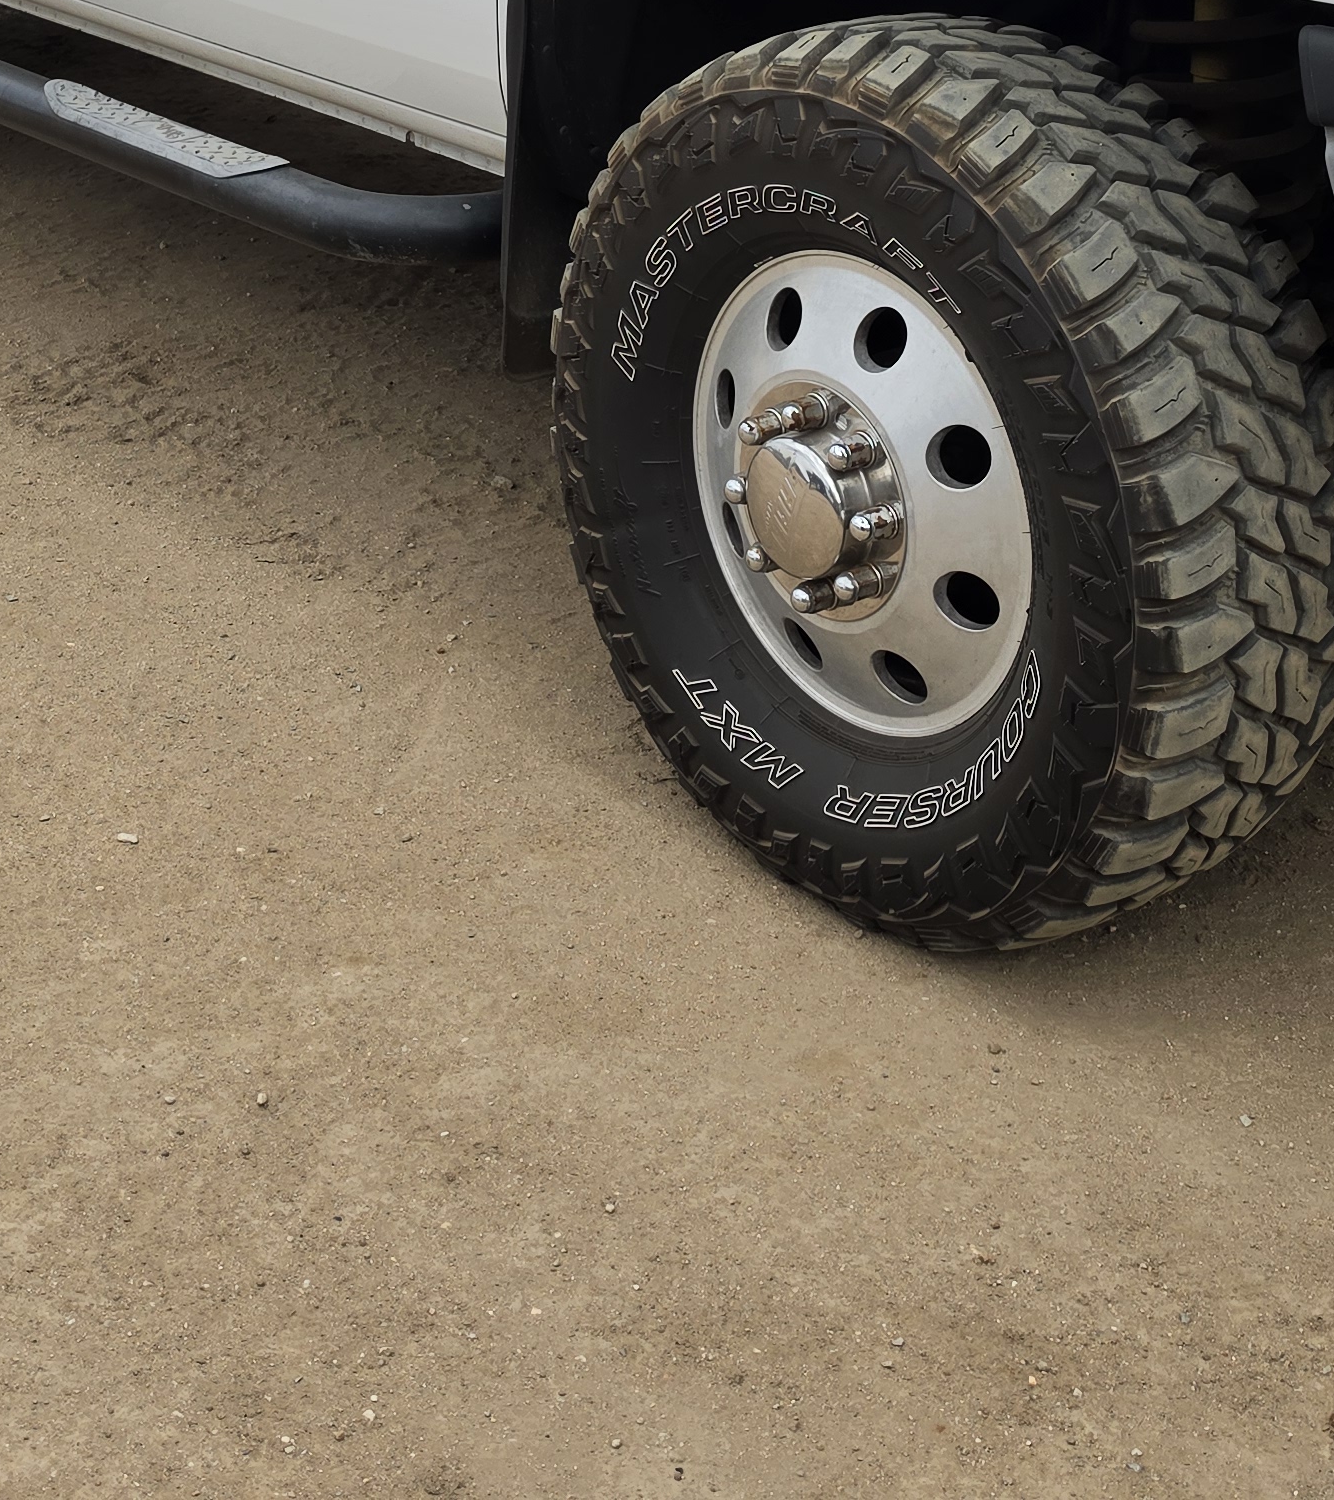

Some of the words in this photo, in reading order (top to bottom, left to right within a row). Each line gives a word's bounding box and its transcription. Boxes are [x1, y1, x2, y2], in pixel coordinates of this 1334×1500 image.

[610, 183, 962, 382] MASTERCRAFT
[672, 668, 805, 789] MXT
[823, 649, 1041, 829] COURSER
